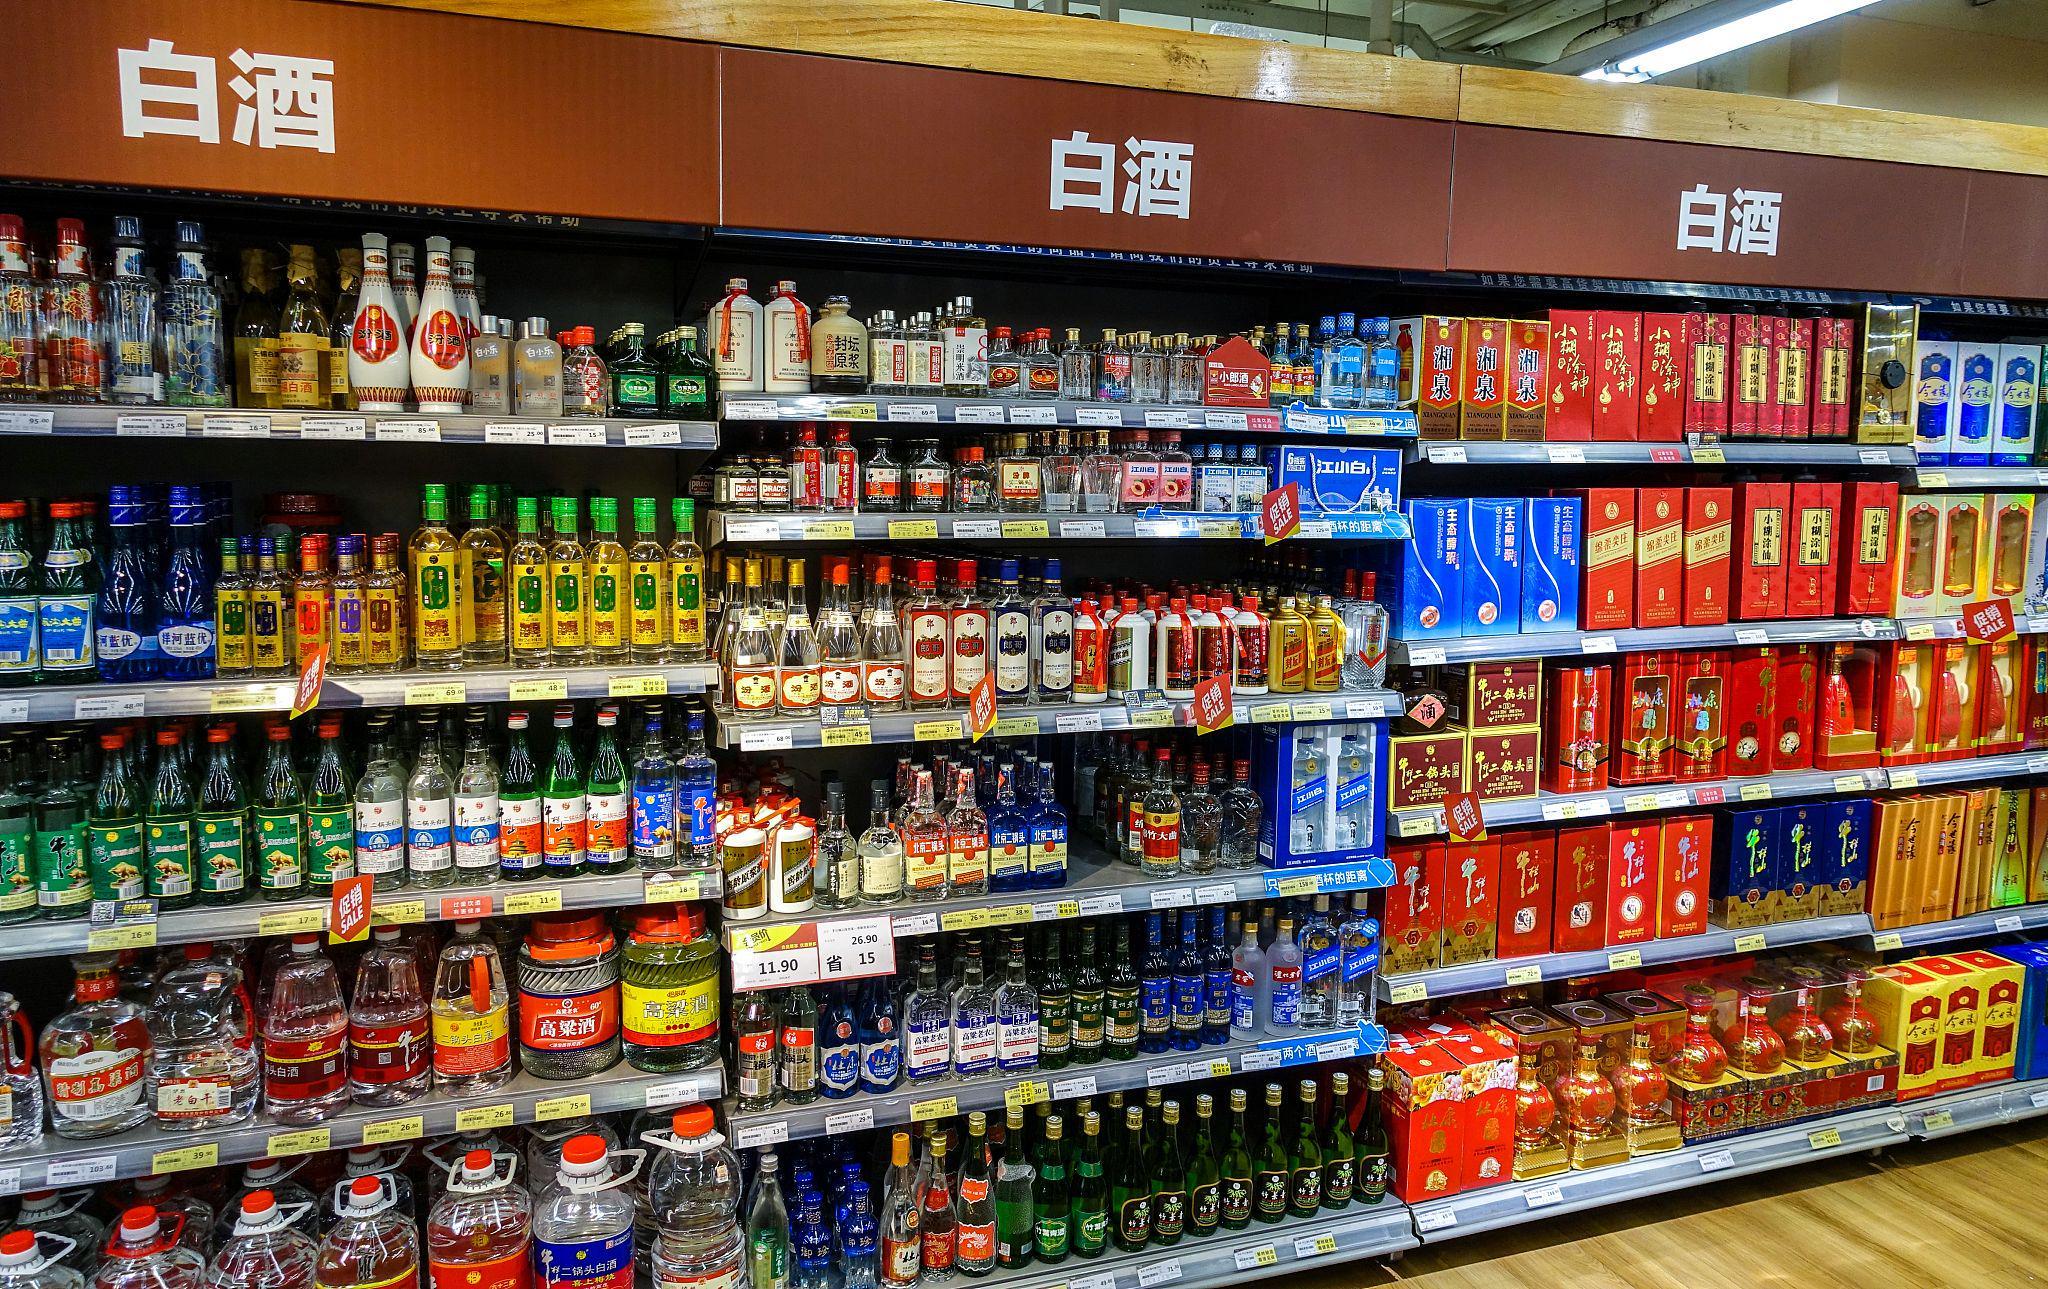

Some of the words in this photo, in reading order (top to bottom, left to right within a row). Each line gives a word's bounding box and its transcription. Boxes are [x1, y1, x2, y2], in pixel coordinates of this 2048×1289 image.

[117, 38, 336, 154] 白酒
[1050, 131, 1194, 218] 白酒
[1676, 183, 1783, 257] 白酒
[358, 329, 391, 341] 汾酒
[428, 333, 460, 346] 汾酒
[955, 344, 965, 380] 崇明米酒
[1107, 356, 1129, 366] 小郎酒
[1219, 371, 1248, 384] 小郎酒
[1430, 346, 1453, 400] 湘泉
[1474, 346, 1496, 401] 湘泉
[1516, 349, 1538, 402] 湘泉
[1705, 349, 1715, 397] 小糊涂仙
[1131, 466, 1156, 474] 江小白
[1164, 466, 1188, 474] 江小白
[1240, 469, 1263, 477] 江小白
[1317, 459, 1370, 474] 江小白
[1269, 490, 1290, 521] 促销
[1273, 509, 1294, 533] SALE
[1762, 514, 1773, 561] 小糊涂仙
[1810, 514, 1822, 561] 小糊涂仙
[1973, 604, 2002, 629] 促销
[1980, 619, 2007, 639] SALE
[162, 633, 210, 646] 洋河蓝优
[300, 677, 317, 707] SALE
[1202, 682, 1223, 714] 促销
[1491, 687, 1526, 701] 二锅头
[978, 703, 991, 730] SALE
[1205, 701, 1226, 726] SALE
[1420, 702, 1436, 720] 酒
[1412, 765, 1451, 779] 二锅头
[1488, 758, 1525, 772] 二锅头
[1297, 785, 1324, 804] 江小白
[1340, 784, 1367, 802] 江小白
[1452, 797, 1474, 825] 促销
[1458, 813, 1479, 836] SALE
[953, 836, 984, 848] 北京二锅头
[994, 832, 1025, 845] 北京二锅头
[1034, 829, 1065, 841] 北京二锅头
[913, 841, 944, 854] 北京二锅头
[339, 881, 363, 919] 促销
[341, 911, 363, 936] SALE
[851, 934, 877, 945] 26.90
[758, 958, 798, 975] 11.90
[826, 955, 842, 972] 省
[858, 952, 875, 965] 15
[1308, 955, 1338, 972] 江小白
[1349, 955, 1378, 971] 江小白
[643, 995, 709, 1019] 高粱酒
[1153, 1006, 1164, 1016] 42
[1182, 1004, 1193, 1013] 42
[1215, 998, 1225, 1007] 42
[540, 1015, 596, 1038] 高粱酒
[173, 1093, 213, 1105] 老白干
[561, 1258, 617, 1276] 二锅头白酒
